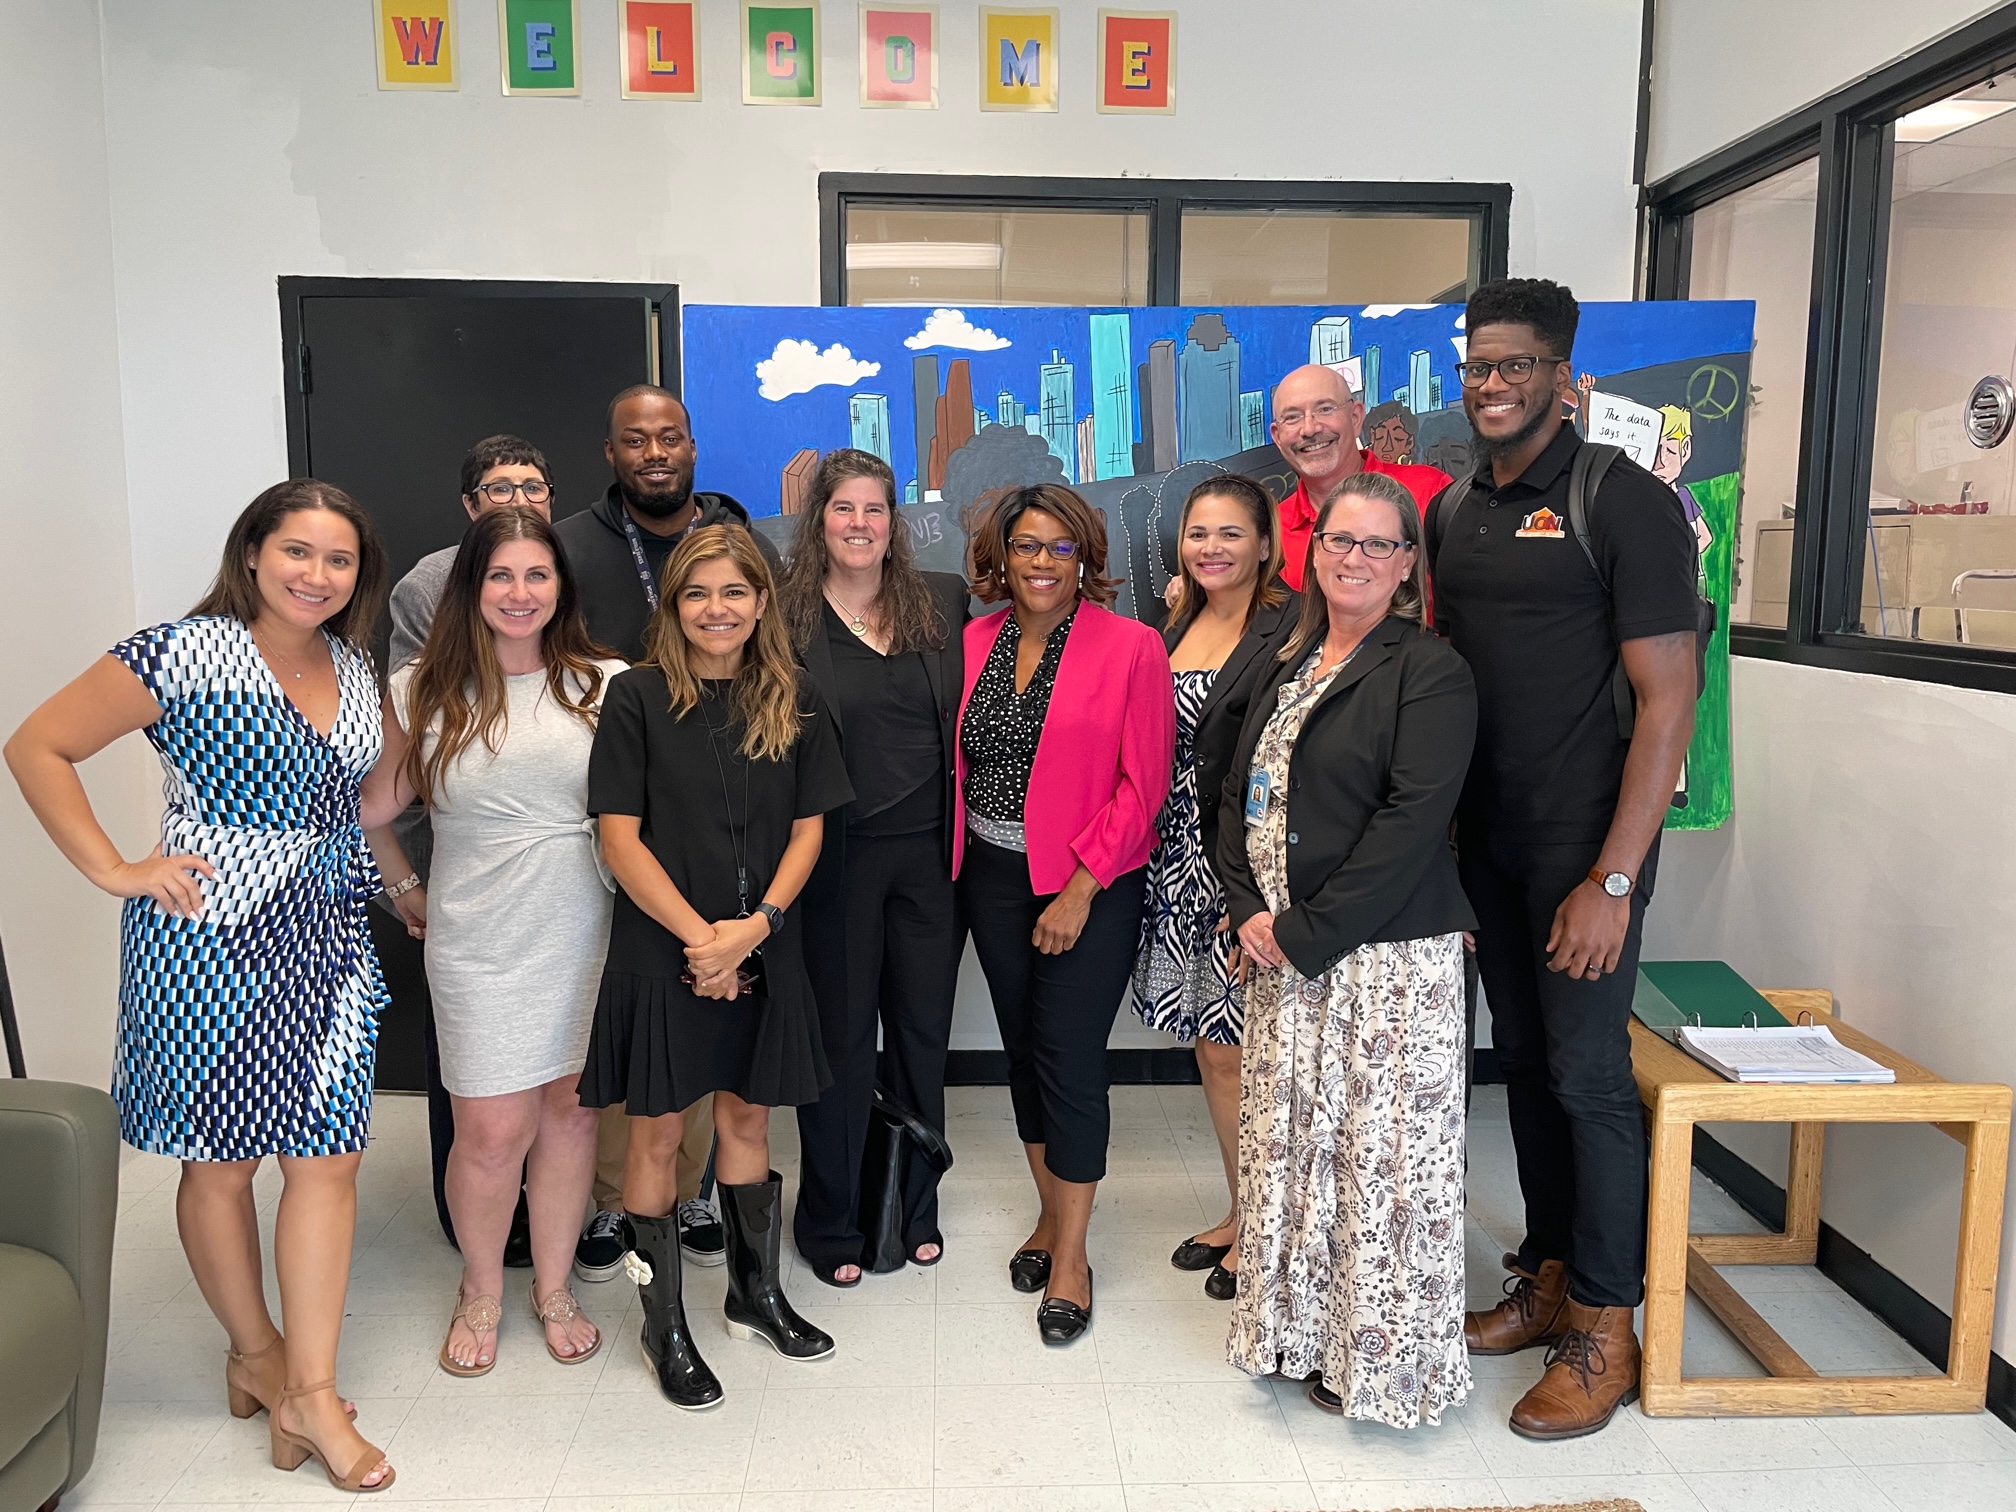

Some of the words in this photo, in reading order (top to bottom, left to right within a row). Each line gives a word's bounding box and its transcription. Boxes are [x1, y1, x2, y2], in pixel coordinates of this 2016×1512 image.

[1603, 407, 1621, 422] The
[1626, 413, 1651, 428] data
[1598, 426, 1620, 440] says
